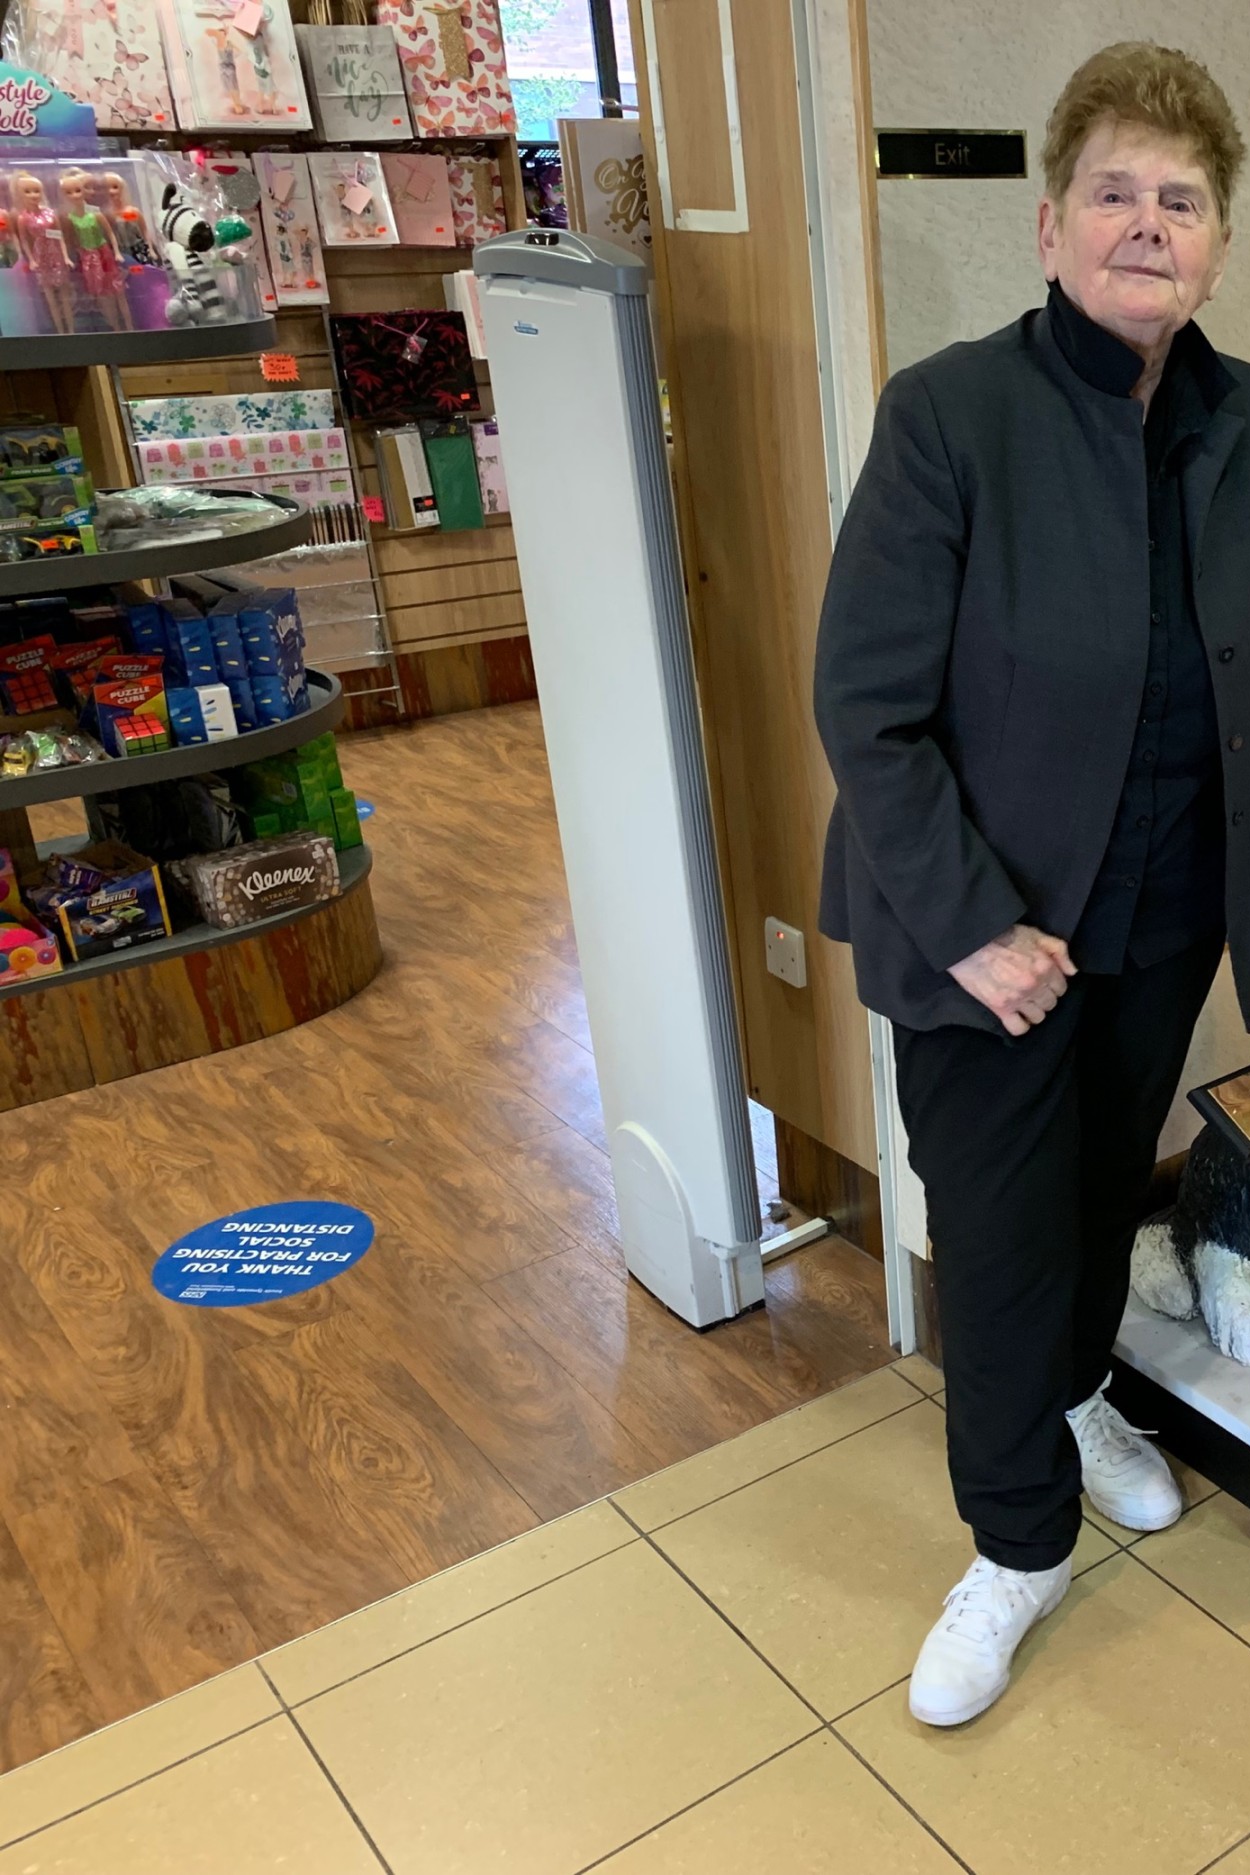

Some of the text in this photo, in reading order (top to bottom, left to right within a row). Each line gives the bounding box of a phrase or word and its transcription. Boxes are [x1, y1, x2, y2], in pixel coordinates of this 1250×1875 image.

[337, 44, 370, 54] HAVE A
[327, 56, 369, 88] nice
[344, 70, 389, 122] day
[0, 110, 34, 129] olls
[935, 143, 970, 165] Exit
[6, 648, 45, 665] PUZZLE
[15, 658, 43, 671] CUBE
[112, 664, 149, 672] PUZZLE
[109, 686, 150, 699] PUZZLE
[117, 694, 145, 705] CUBE
[238, 866, 315, 901] Kleenex
[260, 892, 283, 903] ULTRA
[285, 886, 302, 896] SOFT
[221, 1223, 355, 1235] DISTANCING
[239, 1236, 316, 1247] SOCIAL
[172, 1248, 352, 1262] FOR PRACTISING
[181, 1262, 314, 1276] THANK YOU
